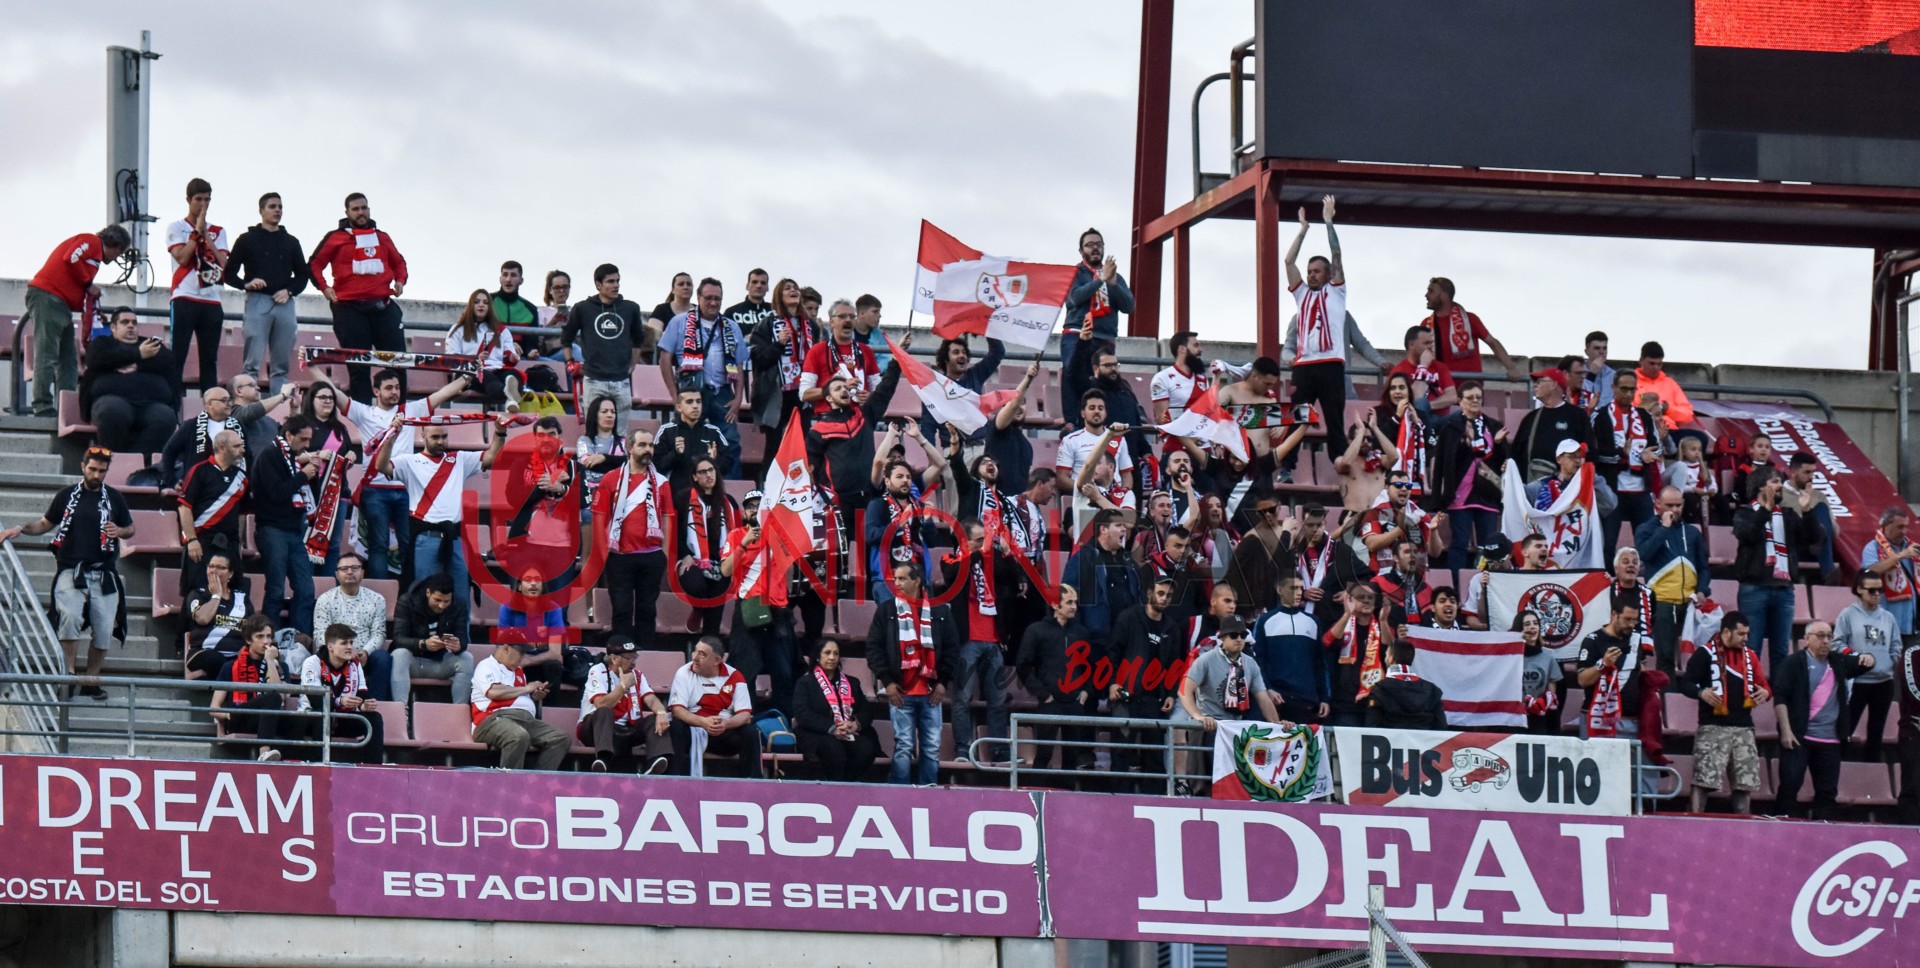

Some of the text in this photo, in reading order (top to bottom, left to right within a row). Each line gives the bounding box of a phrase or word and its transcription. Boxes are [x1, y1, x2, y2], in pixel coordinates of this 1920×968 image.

[1754, 417, 1800, 452] CLUB
[37, 765, 314, 836] DREAM
[1361, 734, 1601, 806] Bus Uno
[346, 796, 1040, 865] GRUPO BARCALO
[95, 880, 152, 903] DEL
[160, 882, 220, 905] SOL
[382, 870, 1008, 915] ESTACIONES DE SERVICIO
[1132, 804, 1670, 931] IDEAL
